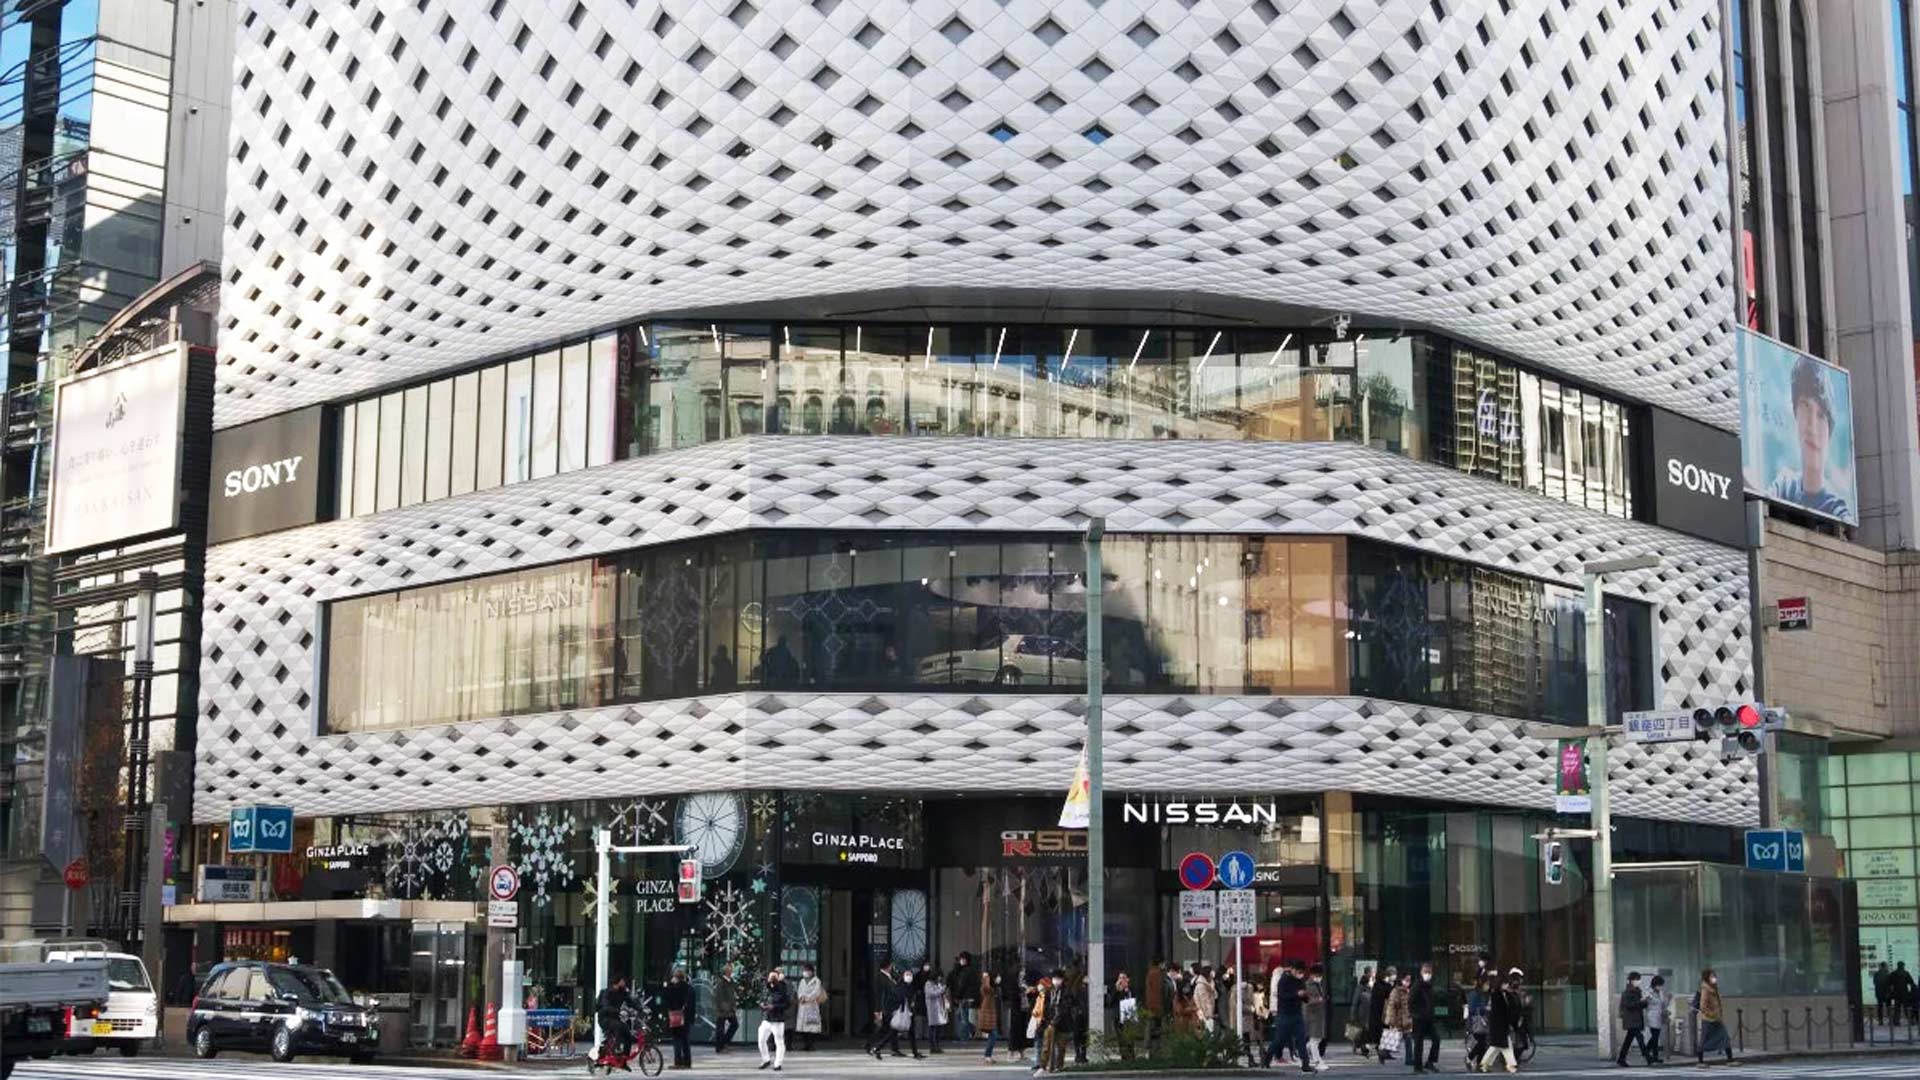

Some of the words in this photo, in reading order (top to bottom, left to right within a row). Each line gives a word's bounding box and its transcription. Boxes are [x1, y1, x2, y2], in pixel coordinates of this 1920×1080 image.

[225, 456, 302, 497] SONY
[1668, 459, 1731, 500] SONY
[486, 591, 570, 618] NISSAN
[1489, 600, 1556, 626] NISSAN
[1124, 803, 1276, 823] NISSAN
[812, 832, 857, 846] GINZA
[860, 835, 904, 849] PLACE
[306, 846, 336, 857] GINZA
[337, 845, 369, 856] PLACE
[848, 853, 878, 862] SAPPORO
[636, 880, 674, 894] GINZA
[636, 898, 676, 912] PLACE
